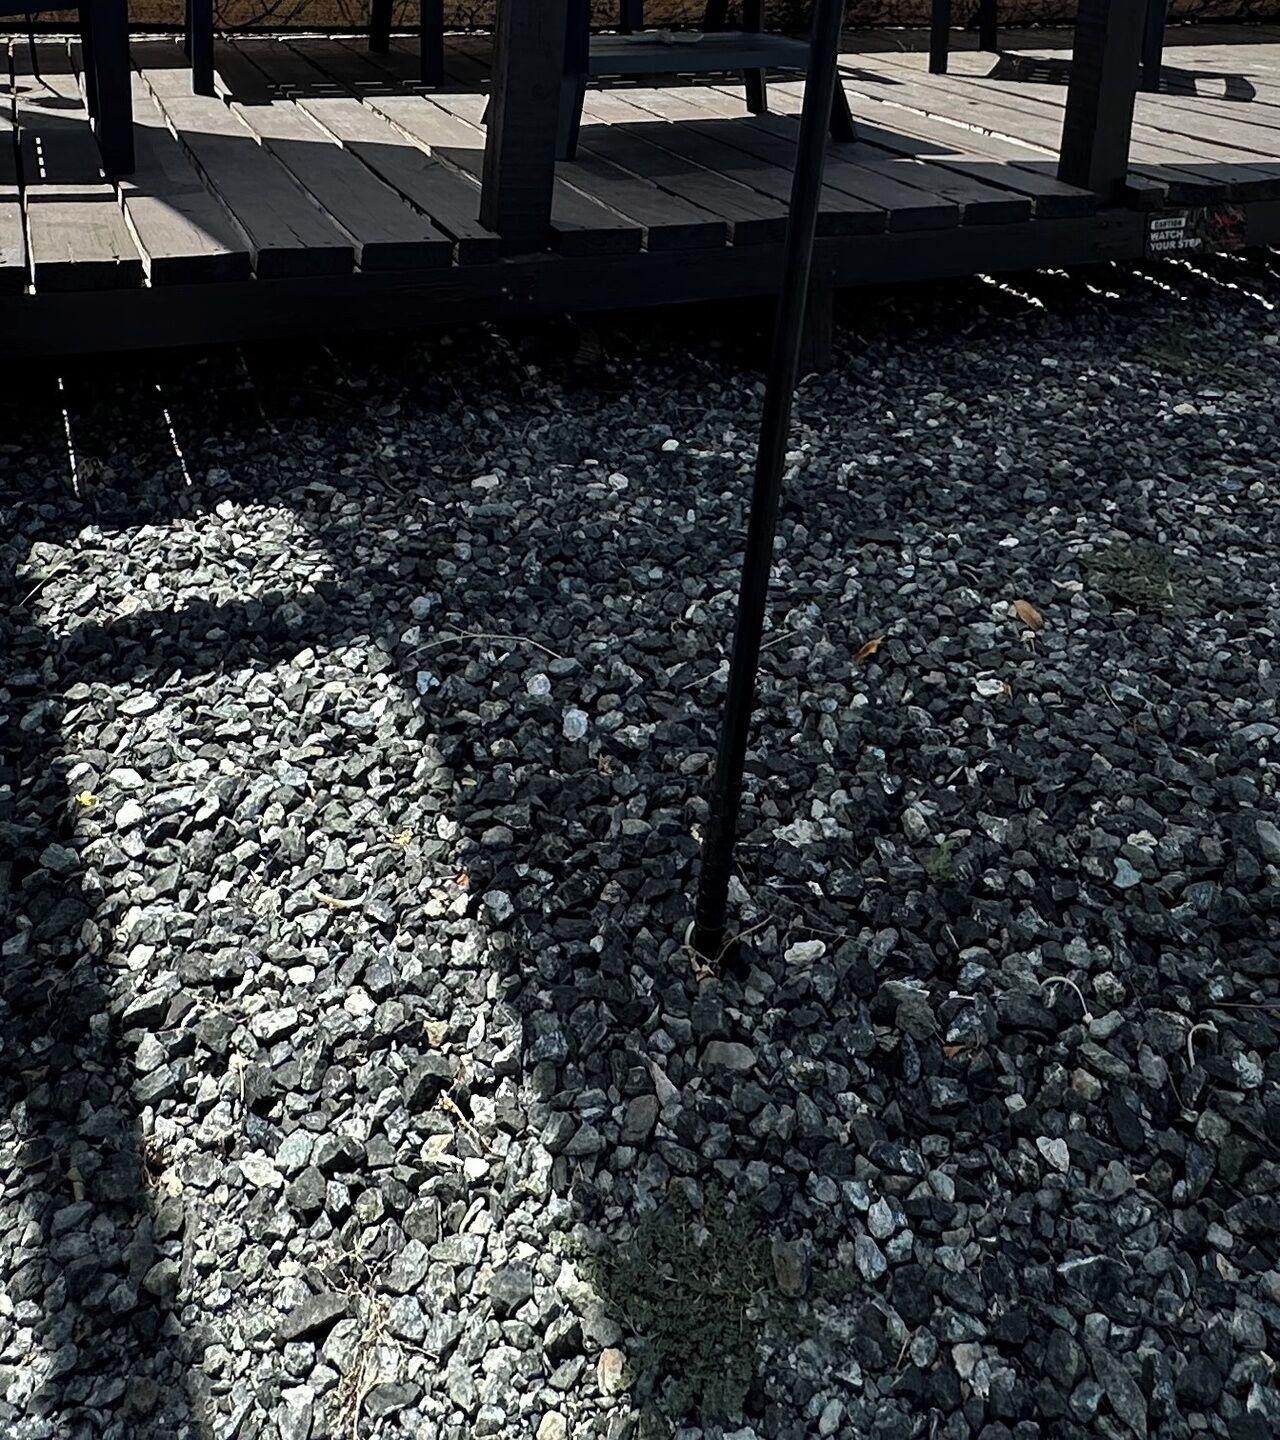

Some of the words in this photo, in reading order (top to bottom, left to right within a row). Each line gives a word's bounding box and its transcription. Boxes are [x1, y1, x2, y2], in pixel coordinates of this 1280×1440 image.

[1150, 229, 1184, 241] WATCH
[1150, 240, 1176, 251] YOUR
[1177, 238, 1201, 249] STEP
